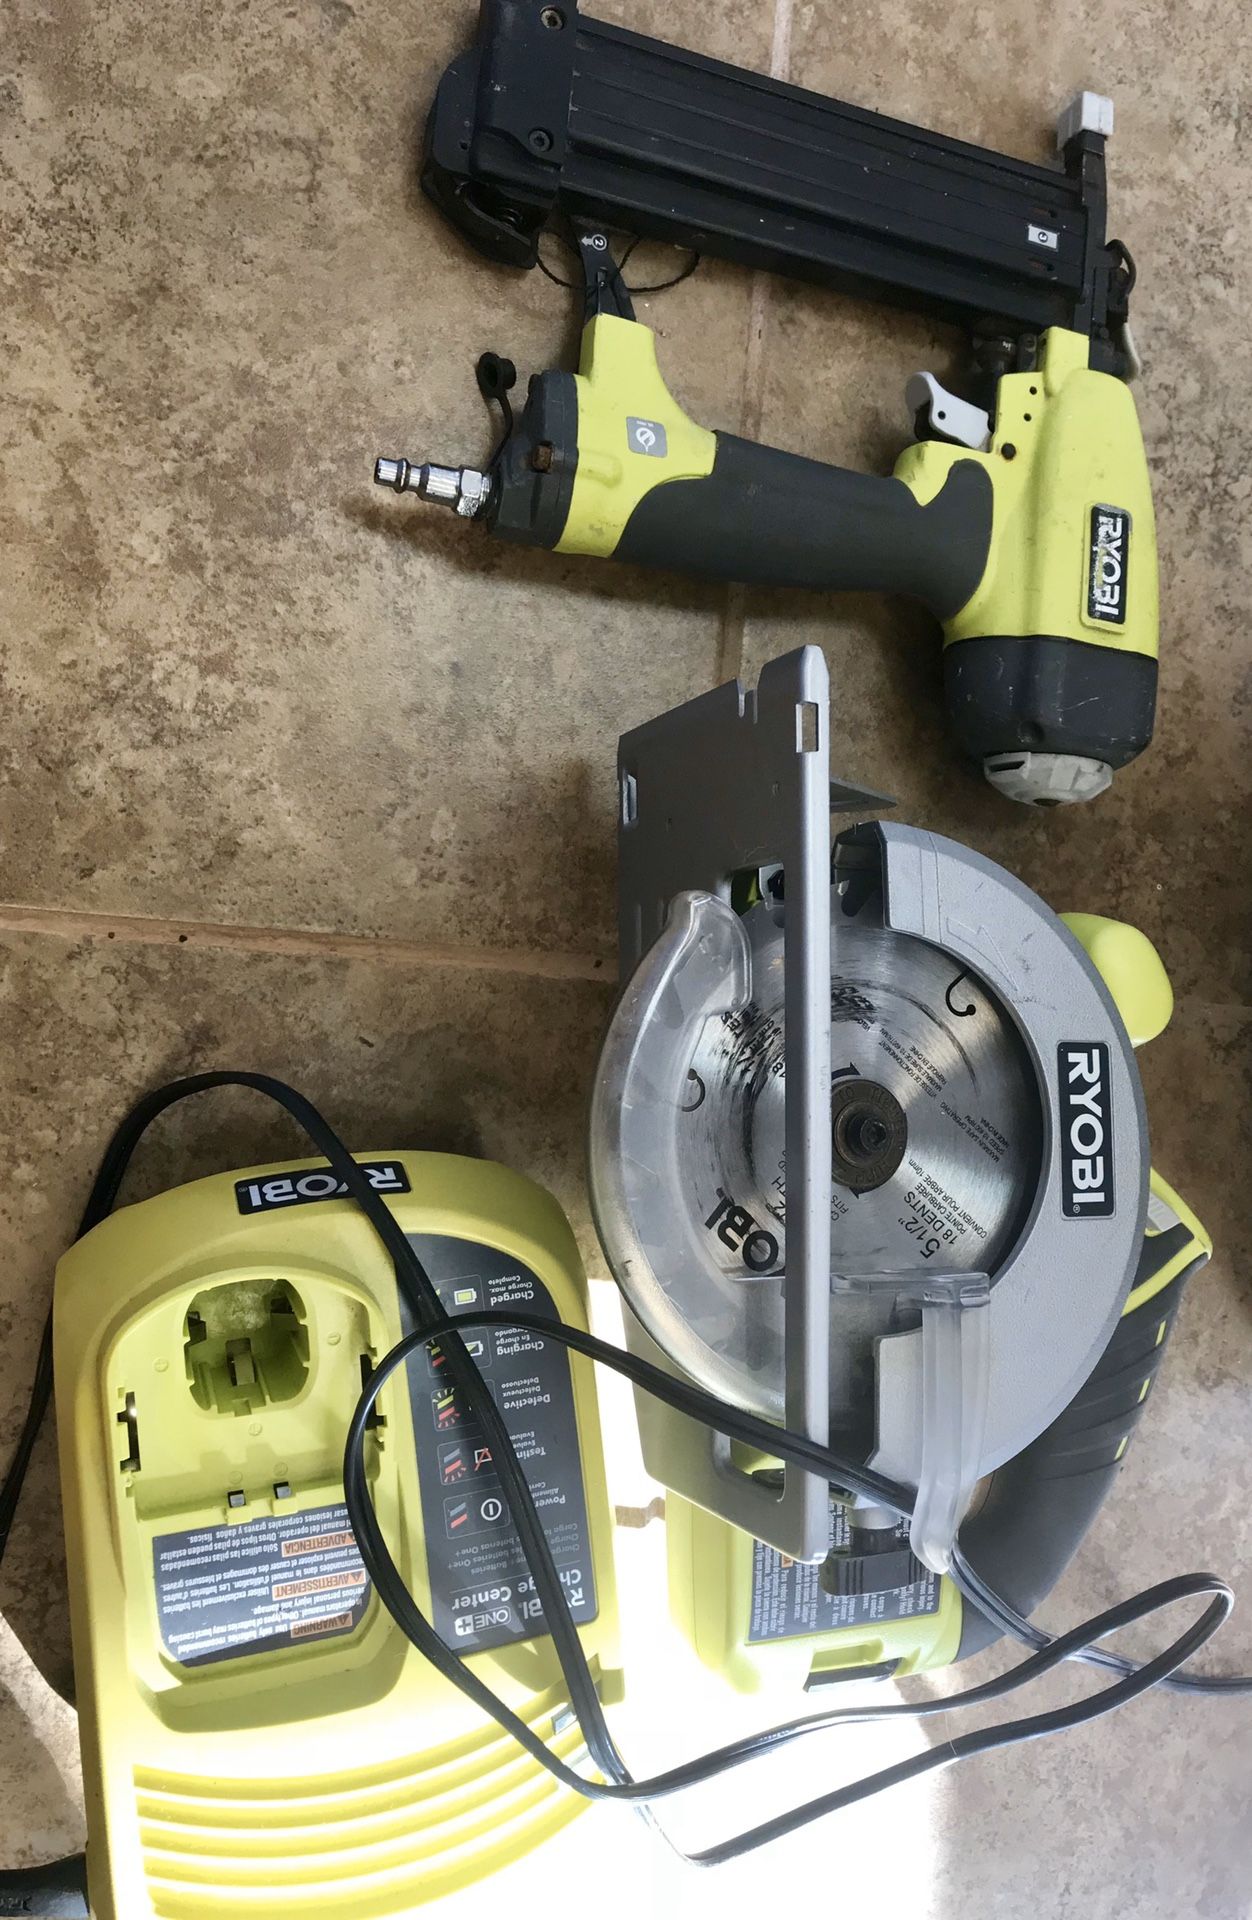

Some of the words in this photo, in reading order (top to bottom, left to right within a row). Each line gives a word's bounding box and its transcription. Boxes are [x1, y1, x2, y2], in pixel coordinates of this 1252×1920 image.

[1067, 1048, 1105, 1203] RYOBI
[906, 1158, 925, 1177] 10mm
[922, 1174, 944, 1196] ARBRE
[941, 1193, 960, 1211] POUR
[904, 1191, 944, 1231] DENTS
[944, 1211, 967, 1234] POINTE
[957, 1209, 987, 1238] CONVIENT
[705, 1196, 779, 1272] OBI
[942, 1229, 957, 1244] 18
[487, 1274, 520, 1285] Completo
[507, 1280, 532, 1290] Charge
[489, 1285, 506, 1294] max.
[489, 1288, 534, 1305] Charged
[495, 1335, 520, 1345] charge
[496, 1338, 543, 1355] Charging
[501, 1376, 538, 1389] Defectuoso
[503, 1393, 550, 1411] Defective
[515, 1446, 545, 1459] Testin
[528, 1481, 545, 1491] Corri
[531, 1487, 559, 1498] Aliment
[533, 1494, 566, 1508] Power
[304, 1510, 333, 1523] lesiones
[333, 1508, 348, 1517] usar
[242, 1521, 266, 1533] graves
[267, 1515, 303, 1530] corporales
[309, 1524, 320, 1533] del
[320, 1519, 345, 1531] manual
[215, 1528, 237, 1539] daños
[236, 1525, 242, 1534] y
[276, 1525, 309, 1539] operador.
[186, 1532, 213, 1544] físicos.
[231, 1538, 240, 1547] de
[240, 1534, 258, 1545] tipos
[258, 1531, 277, 1542] Otros
[187, 1542, 213, 1555] pueden
[213, 1539, 231, 1550] pilas
[262, 1541, 278, 1553] Sólo
[283, 1532, 347, 1555] ADVERTENCIA
[159, 1548, 187, 1561] estallar
[211, 1550, 229, 1563] pilas
[229, 1549, 241, 1559] las
[240, 1545, 263, 1557] utilice
[323, 1547, 348, 1560] peuvent
[454, 1545, 479, 1558] One+
[472, 1549, 509, 1564] batteries
[160, 1554, 212, 1573] recomendadas
[269, 1560, 290, 1570] causer
[290, 1559, 297, 1567] et
[297, 1552, 323, 1565] exploser
[447, 1558, 471, 1571] One+
[222, 1564, 257, 1580] dommages
[257, 1563, 269, 1573] des
[294, 1569, 301, 1577] le
[302, 1566, 318, 1575] dans
[470, 1560, 507, 1576] Batteries
[184, 1574, 215, 1588] blessures
[214, 1573, 222, 1581] et
[270, 1570, 294, 1582] manuel
[515, 1565, 582, 1597] Chge
[159, 1579, 184, 1592] graves.
[218, 1582, 231, 1592] Les
[273, 1572, 350, 1597] AVERTISSEMENT
[189, 1585, 218, 1598] batteries
[246, 1585, 269, 1598] Utiliser
[312, 1589, 341, 1604] personal
[191, 1599, 201, 1609] les
[201, 1590, 247, 1607] exclusivement
[293, 1595, 313, 1607] injury
[449, 1585, 512, 1612] Center
[162, 1601, 191, 1615] batteries
[250, 1601, 280, 1616] damage.
[292, 1616, 337, 1635] WARNING
